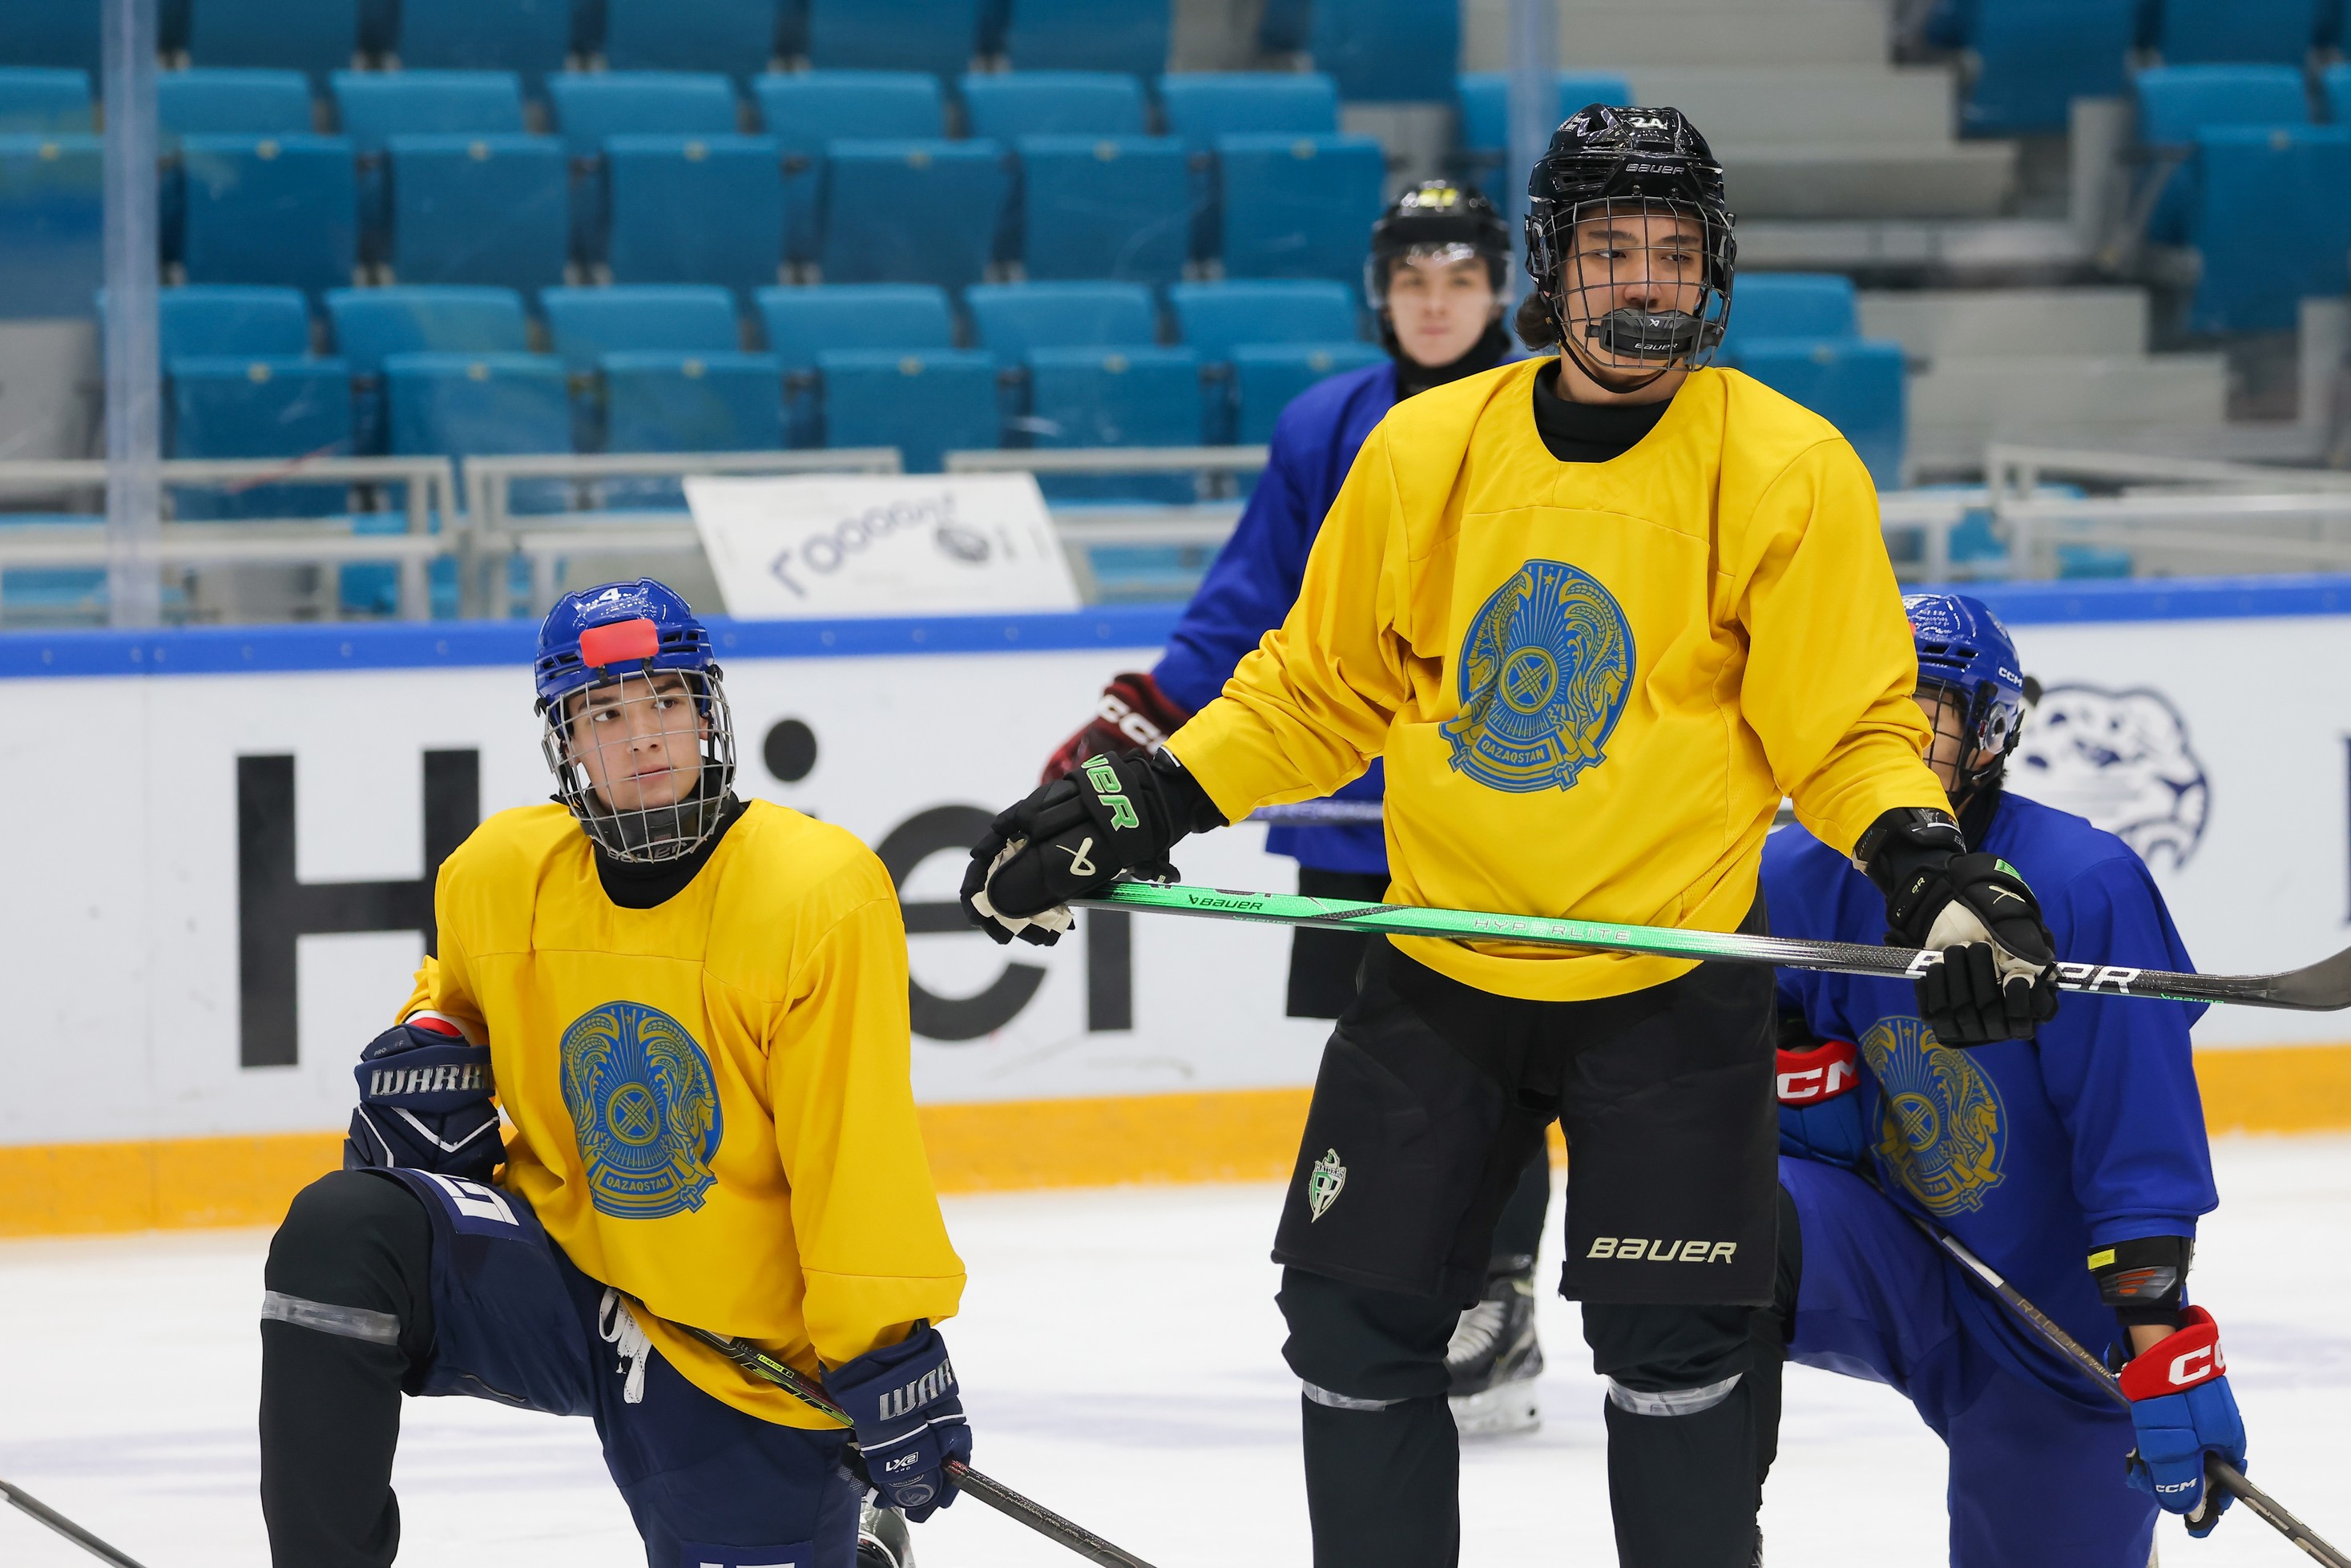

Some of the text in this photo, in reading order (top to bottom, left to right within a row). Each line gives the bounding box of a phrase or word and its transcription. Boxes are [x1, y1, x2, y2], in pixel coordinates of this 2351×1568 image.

[1998, 667, 2023, 687] CCM
[1481, 740, 1546, 764] QAZAQSTAN
[1200, 897, 1264, 911] BAUER
[369, 1063, 494, 1098] WARR
[606, 1176, 670, 1192] QAZAQSTAN
[1586, 1236, 1737, 1264] BAUER
[2155, 1477, 2197, 1493] CCM
